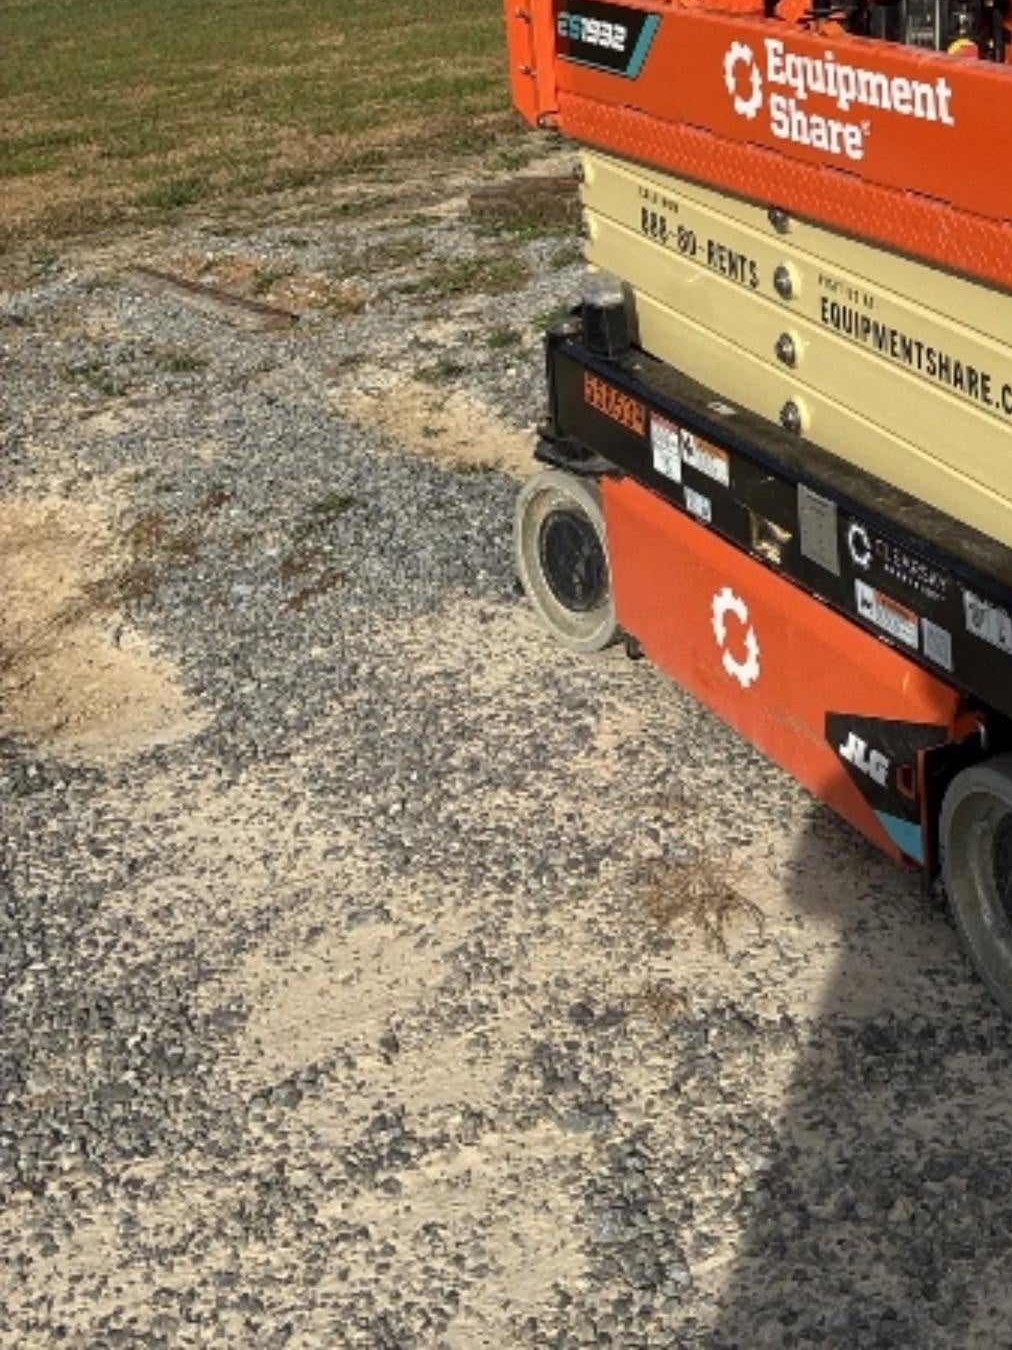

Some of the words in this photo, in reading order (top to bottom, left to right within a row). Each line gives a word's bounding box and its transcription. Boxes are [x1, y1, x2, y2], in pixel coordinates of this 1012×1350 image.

[764, 38, 955, 125] Equipment
[641, 206, 759, 290] 888-80-RENTS
[838, 731, 891, 787] JLG
